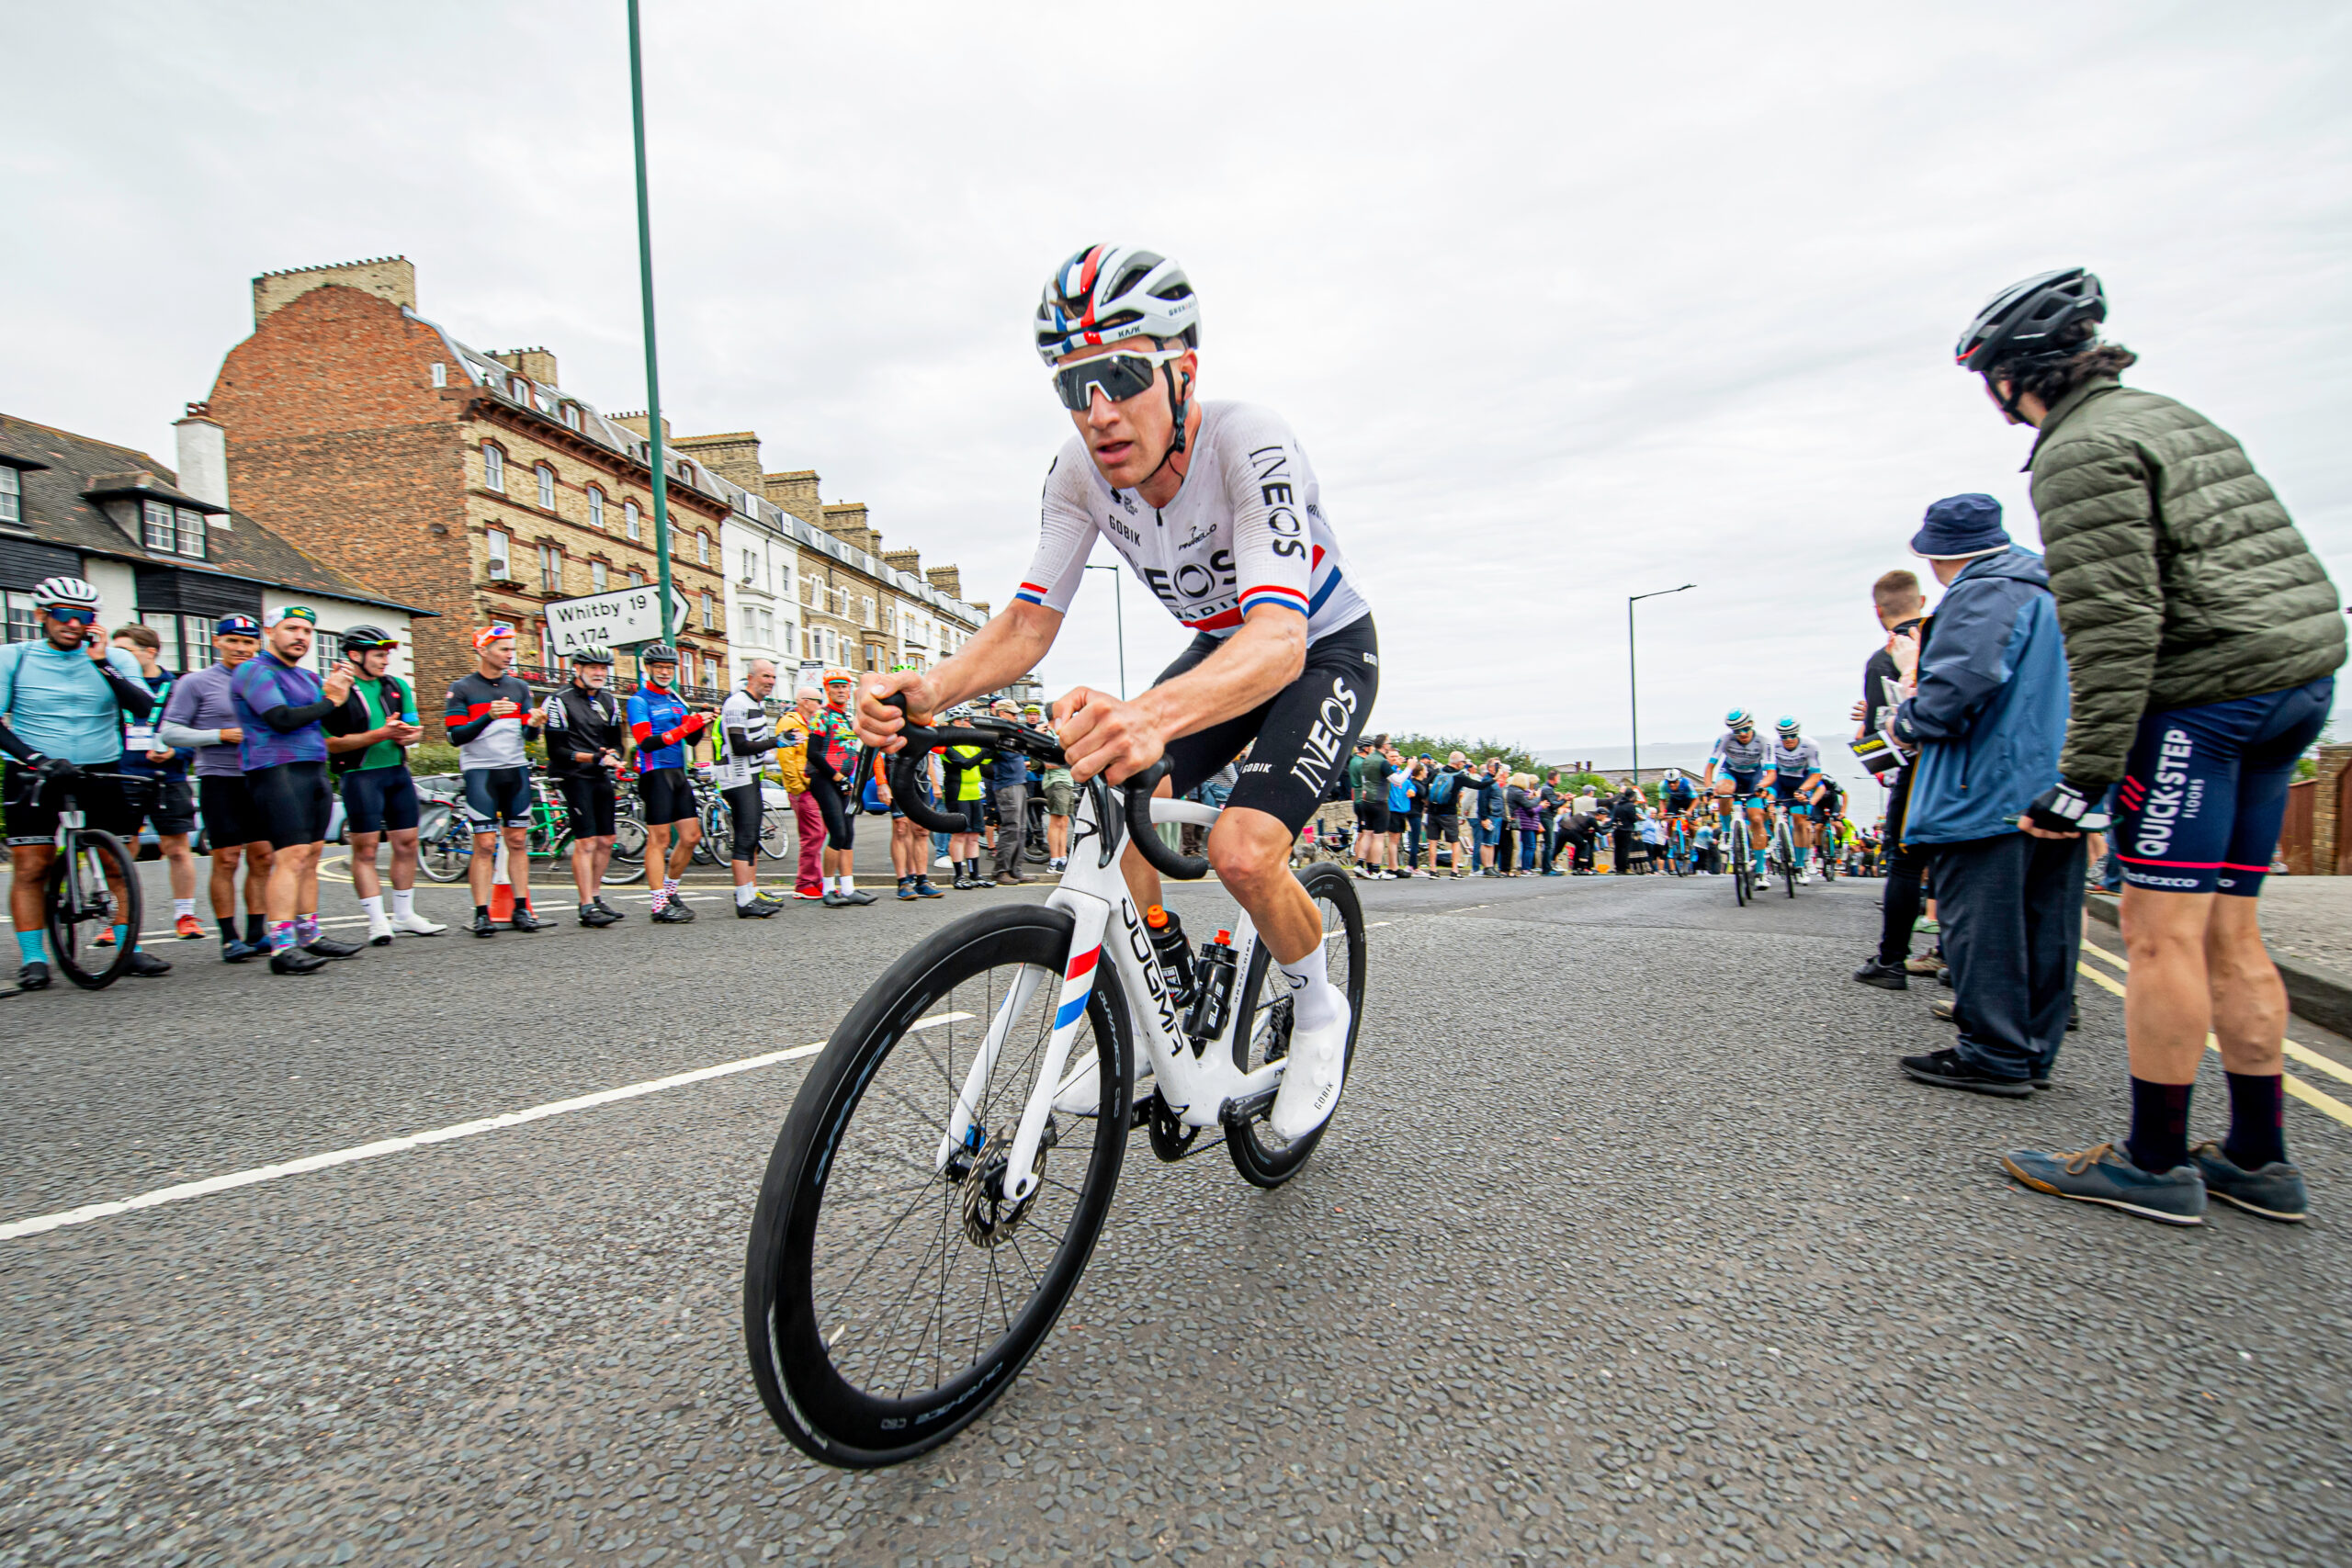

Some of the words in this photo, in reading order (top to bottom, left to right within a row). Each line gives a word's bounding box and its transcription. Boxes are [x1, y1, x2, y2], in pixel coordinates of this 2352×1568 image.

[1118, 324, 1140, 338] KASK
[1249, 446, 1306, 560] INEOS
[1109, 514, 1141, 547] GOBIK
[557, 602, 621, 623] Whitby
[629, 594, 647, 611] 19
[565, 633, 577, 647] A
[581, 626, 609, 644] 174
[1290, 676, 1358, 798] INEOS
[1241, 761, 1272, 774] GOBIK
[2181, 778, 2205, 819] FLOORS
[1121, 896, 1184, 1058] DOGMA
[1314, 1081, 1334, 1110] GOBIK
